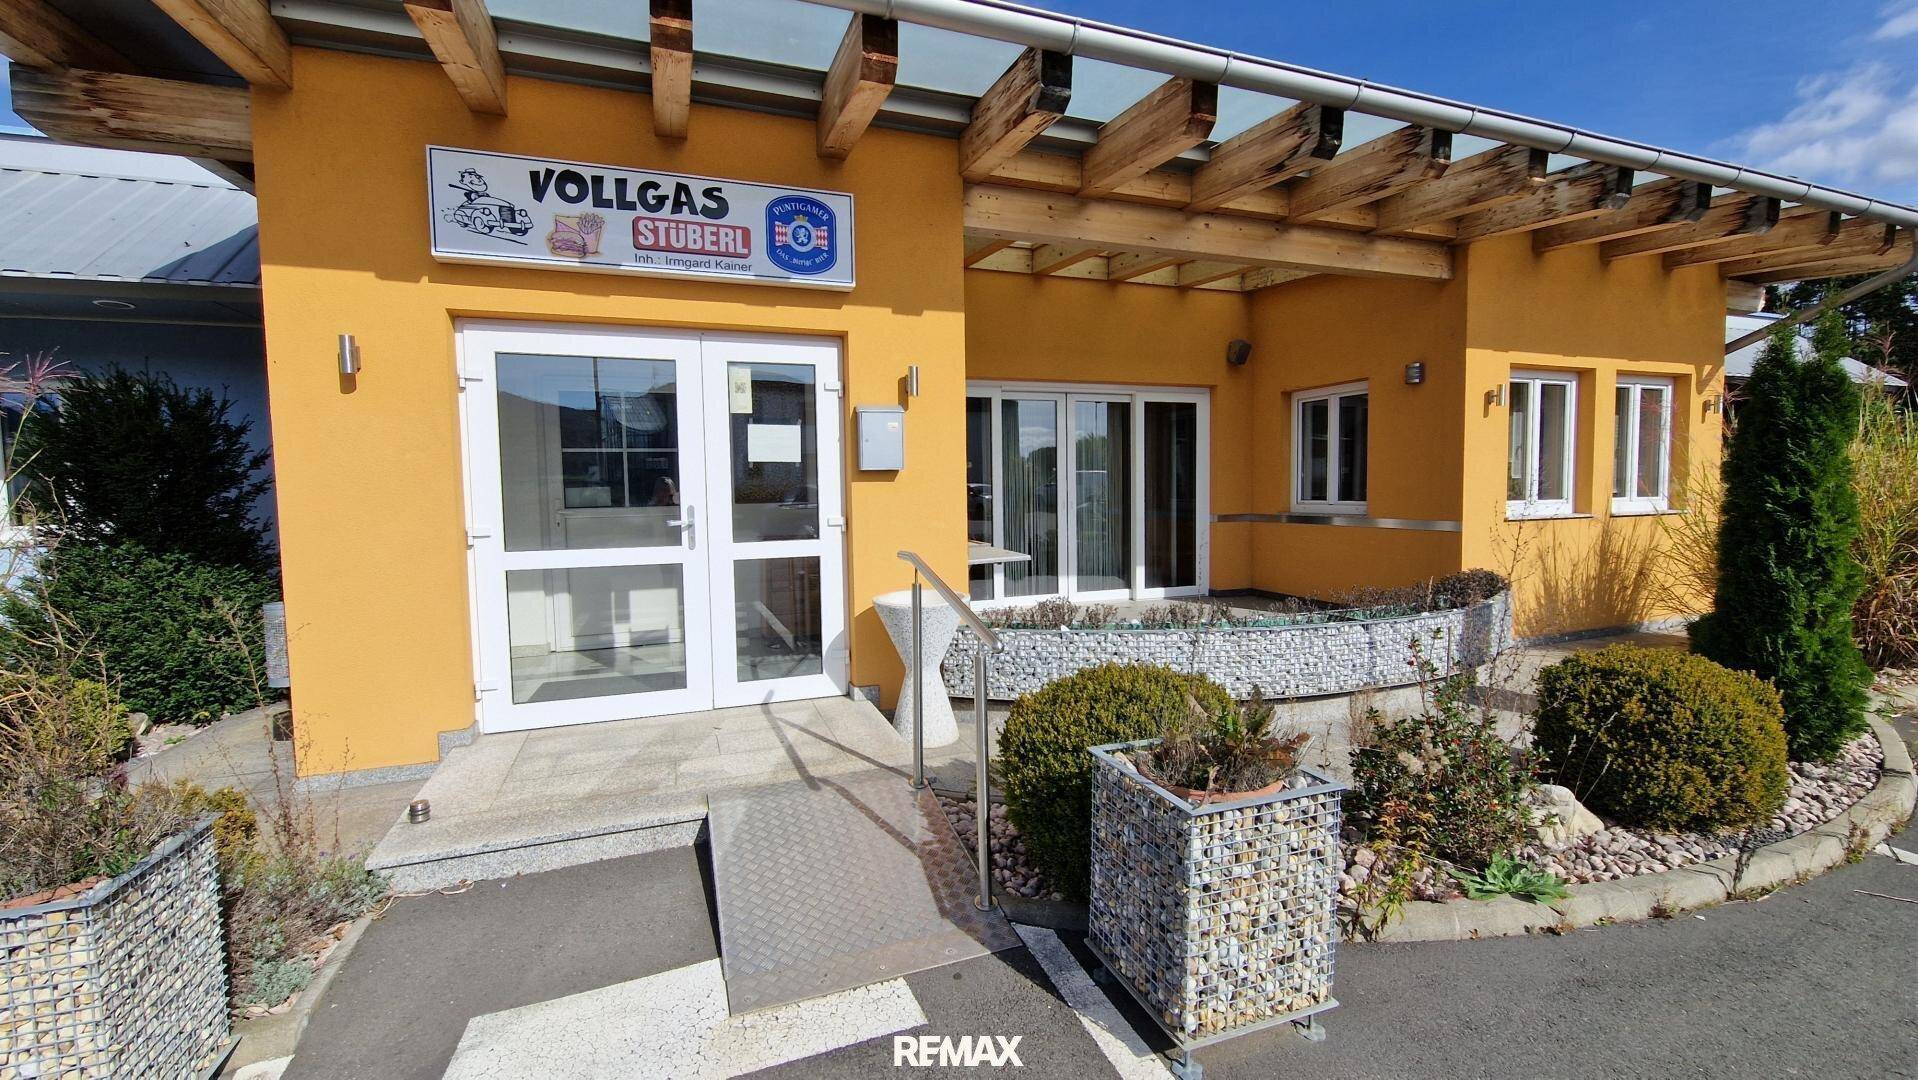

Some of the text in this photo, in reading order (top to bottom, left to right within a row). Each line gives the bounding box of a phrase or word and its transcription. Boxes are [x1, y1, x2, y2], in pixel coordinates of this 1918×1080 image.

[529, 167, 729, 220] VOLLGAS
[773, 202, 829, 222] PUNTIGAMER
[665, 255, 711, 269] Irmgard
[715, 260, 753, 272] Kainer
